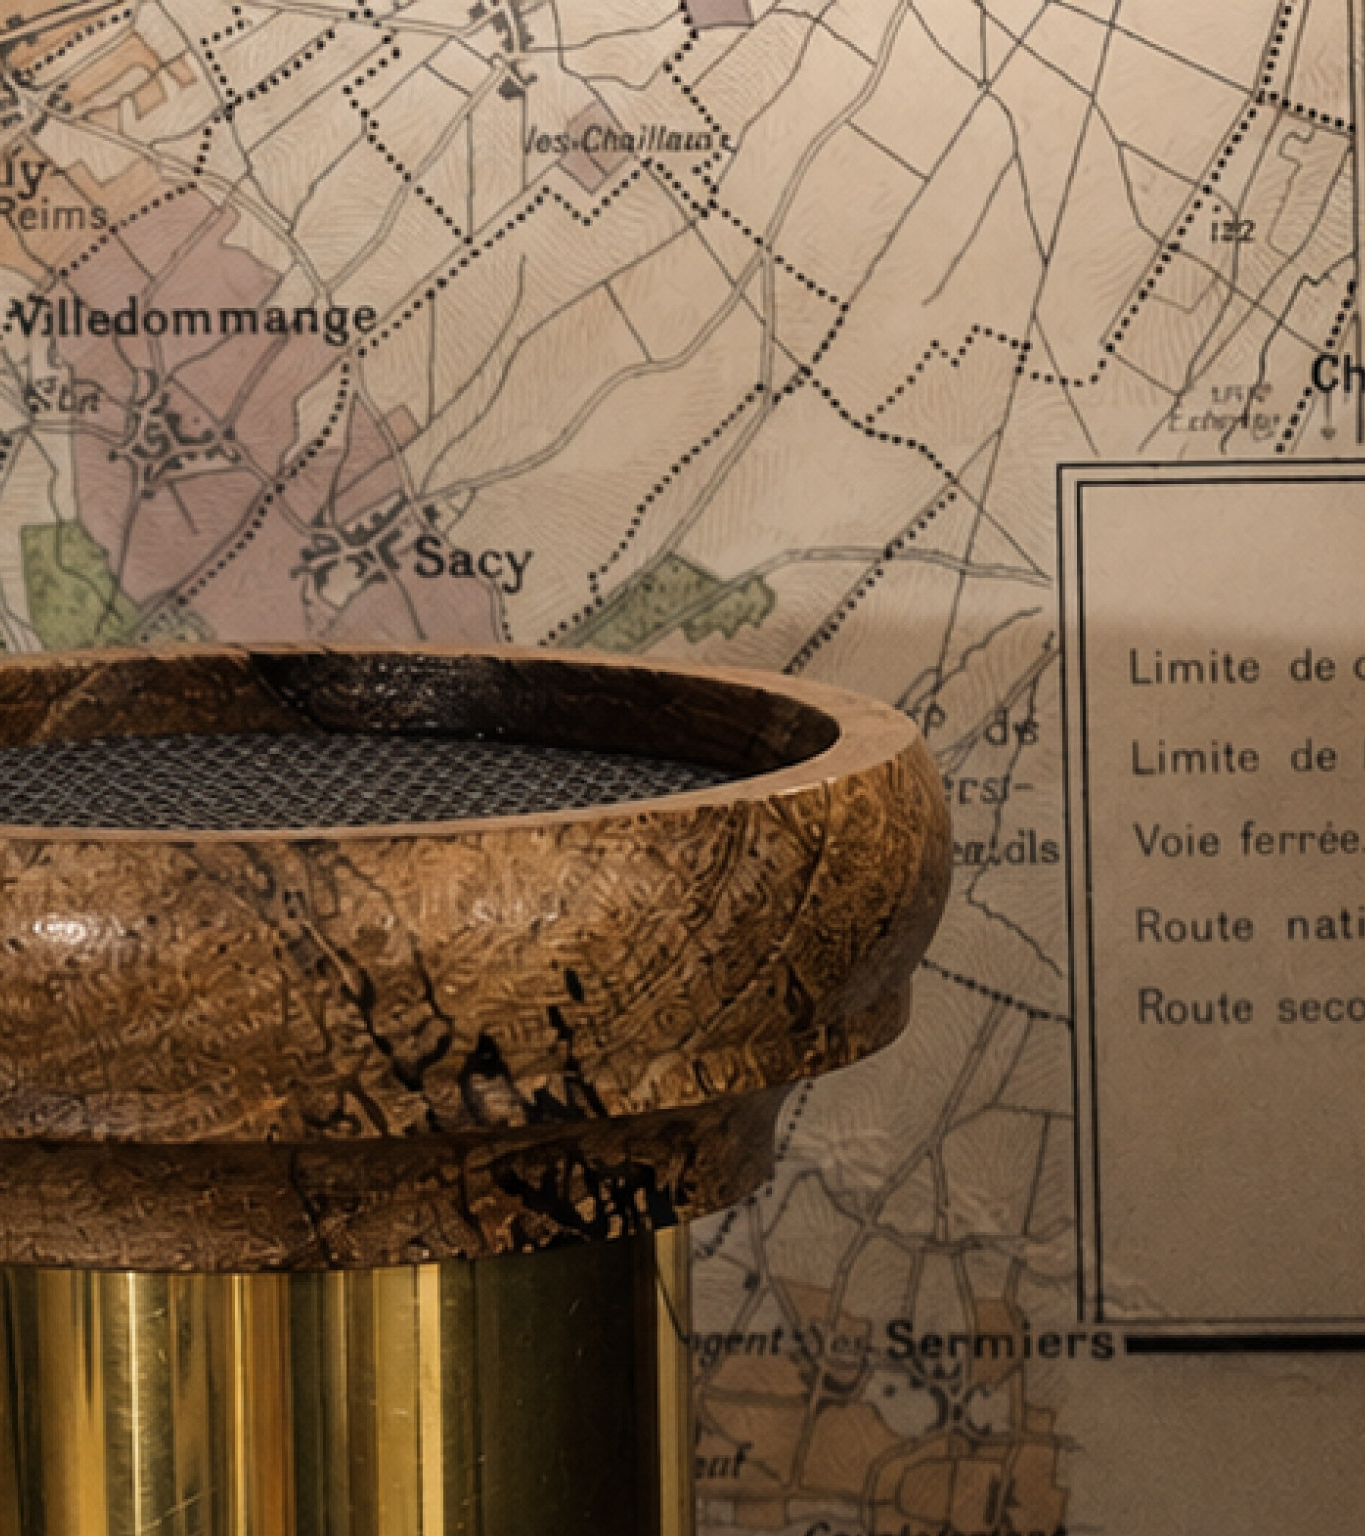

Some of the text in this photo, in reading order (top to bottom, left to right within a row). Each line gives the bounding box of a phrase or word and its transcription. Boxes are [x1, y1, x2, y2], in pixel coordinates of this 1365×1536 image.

[9, 292, 379, 346] Villedommange
[413, 533, 535, 595] Sacy
[1129, 647, 1261, 686] Limite
[1287, 647, 1336, 684] de
[1131, 737, 1338, 777] Limite de
[1132, 819, 1221, 858] Voie
[1135, 905, 1254, 943] Route
[1137, 985, 1254, 1025] Route
[886, 1319, 1116, 1362] Sermiers
